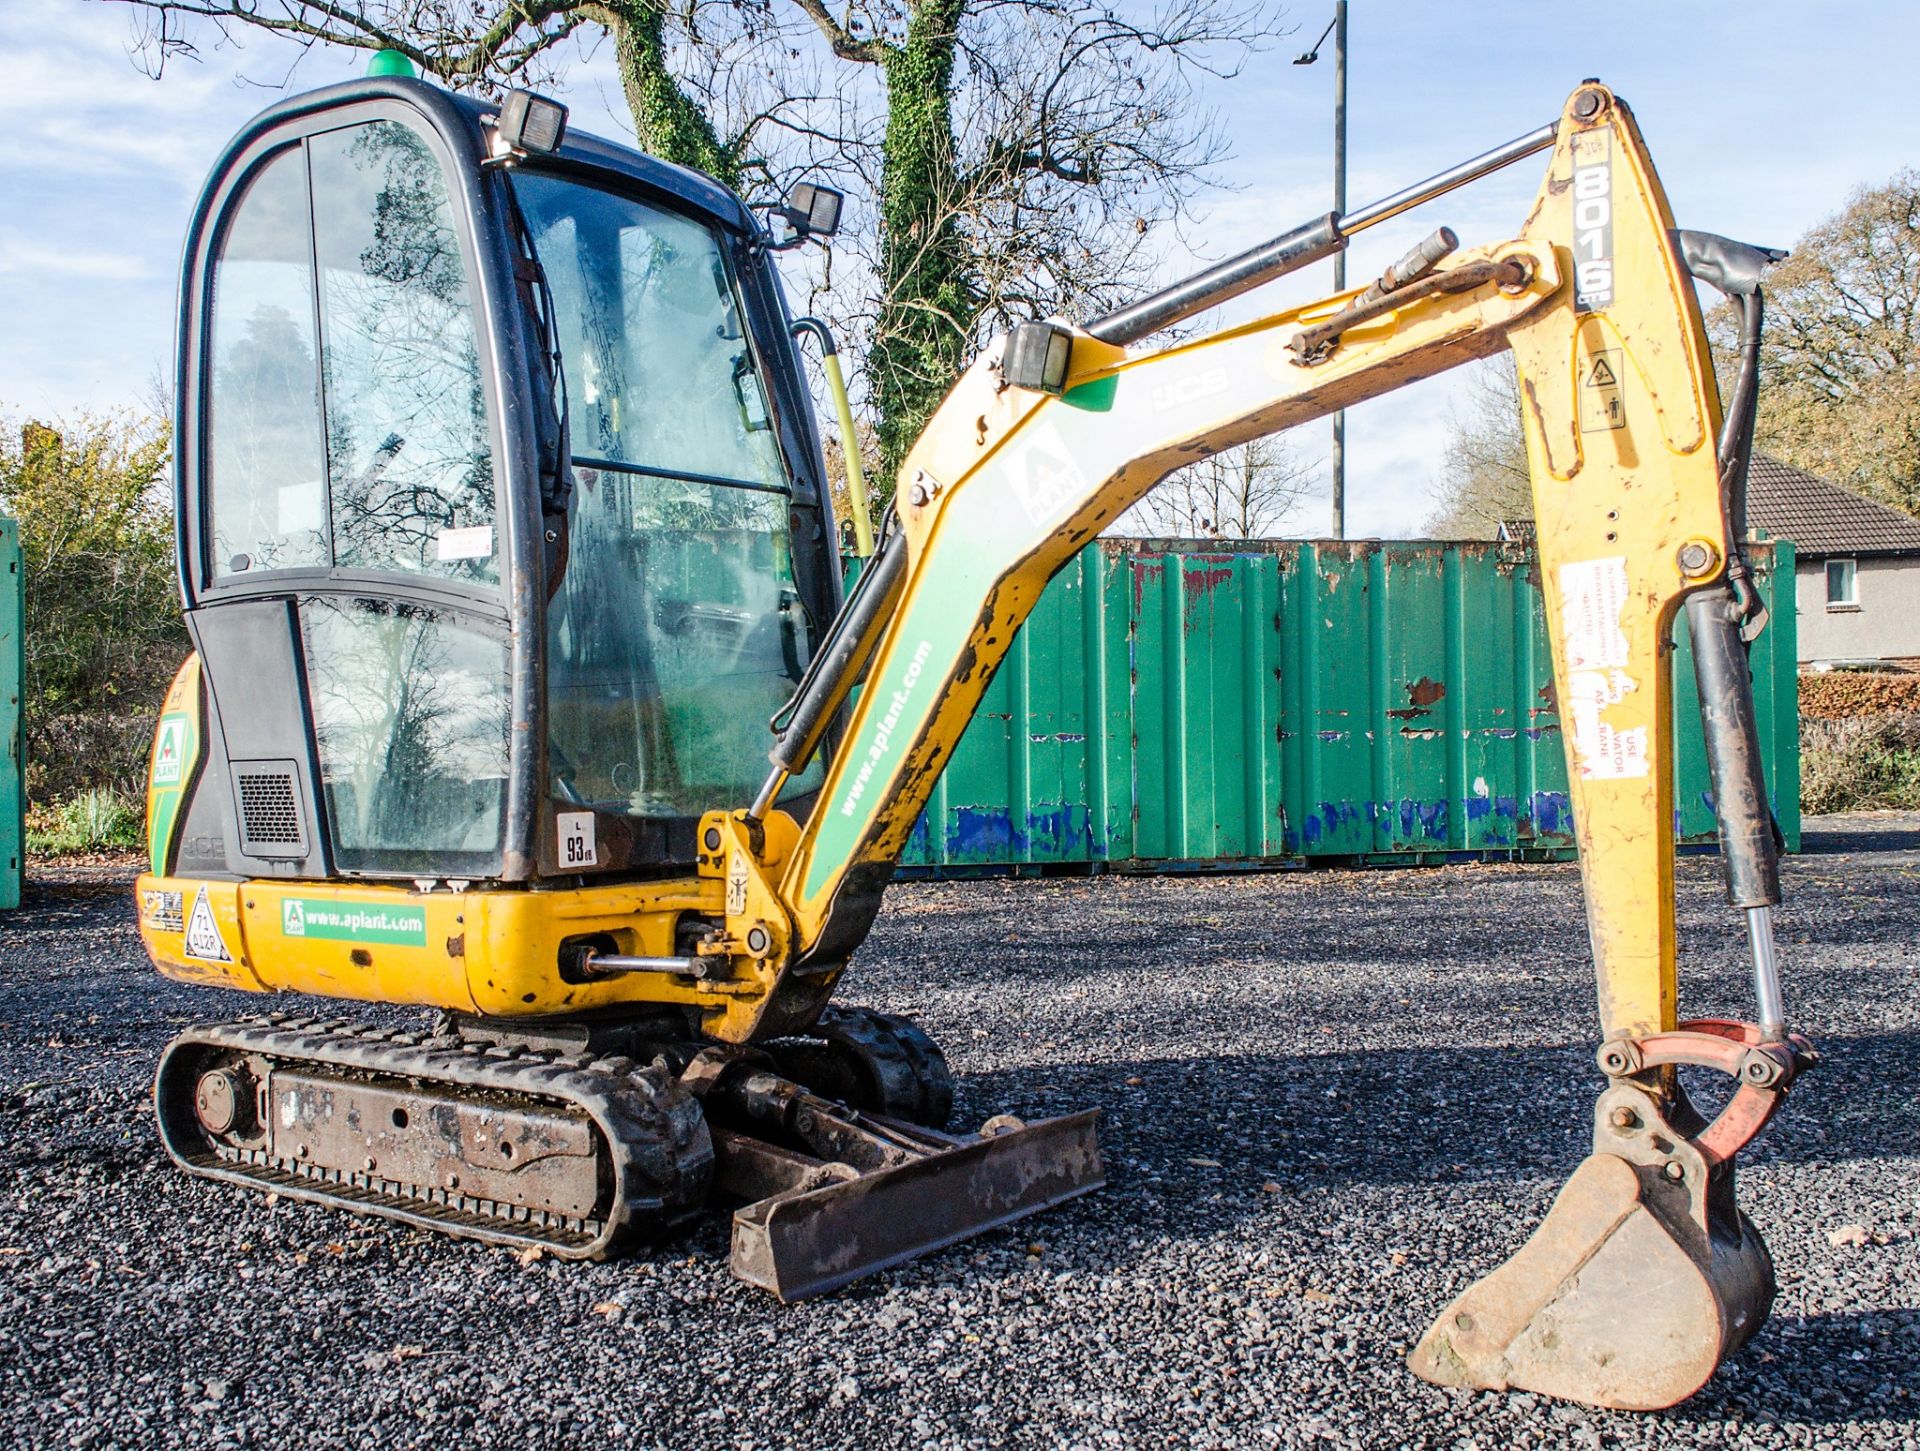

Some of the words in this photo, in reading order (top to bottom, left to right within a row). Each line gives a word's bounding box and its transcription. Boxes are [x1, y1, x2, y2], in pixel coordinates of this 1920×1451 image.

[1574, 165, 1612, 294] 8016
[1152, 367, 1229, 411] JCB
[1030, 469, 1080, 522] PLANT
[841, 640, 933, 817] www.aplant.com
[1598, 727, 1609, 759] RANE
[158, 726, 177, 761] A
[1626, 736, 1637, 759] USE
[155, 764, 179, 778] PLANT
[575, 821, 582, 831] L
[567, 836, 584, 862] 93
[197, 914, 209, 931] 71
[305, 910, 423, 933] www.aplant.com
